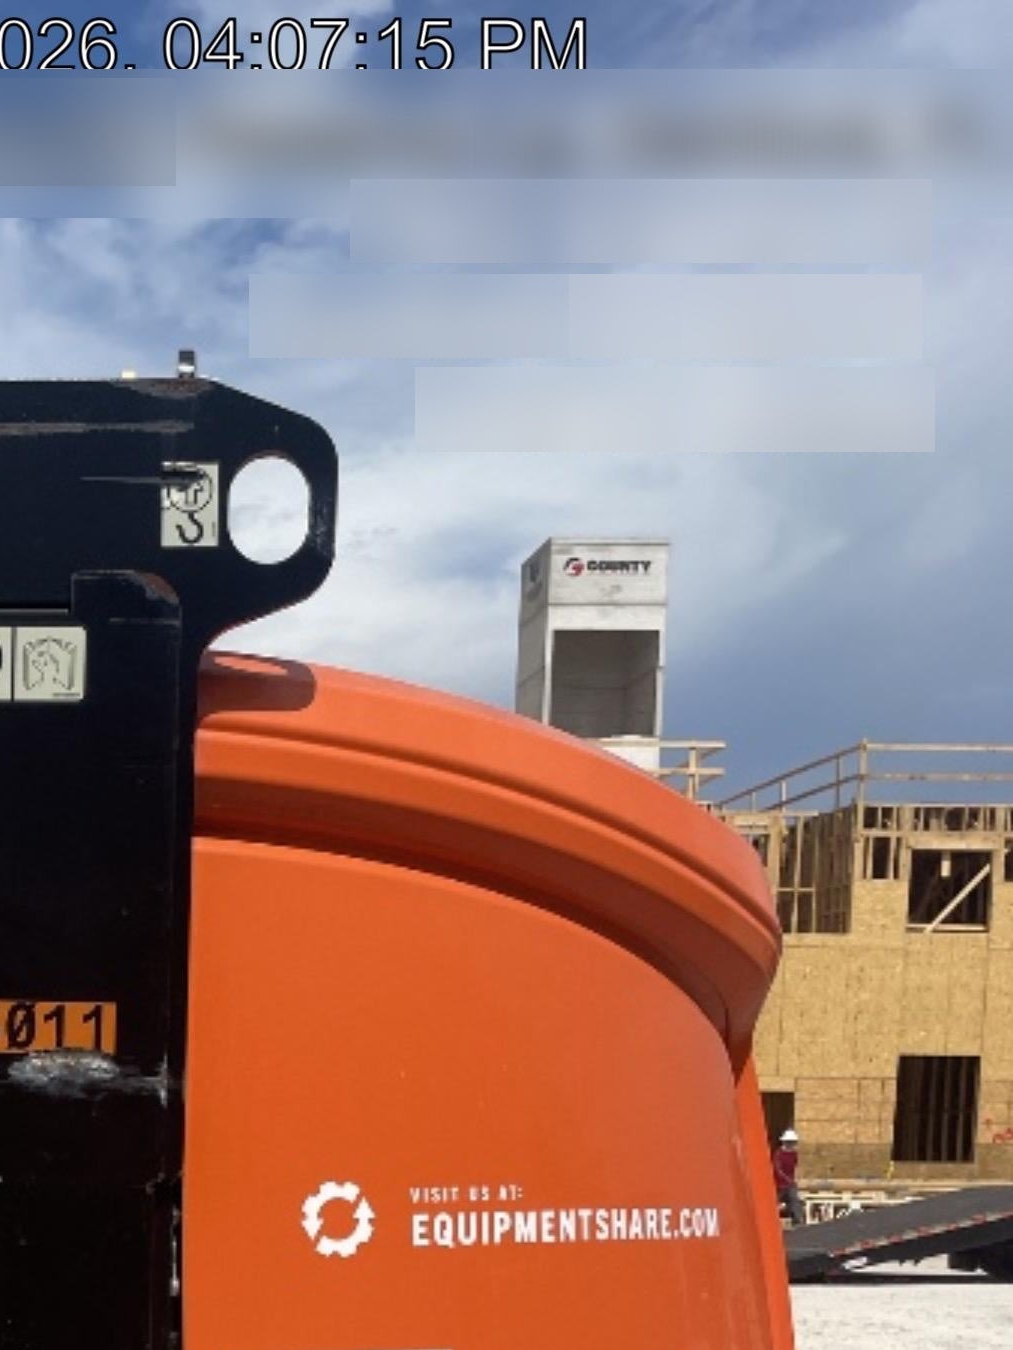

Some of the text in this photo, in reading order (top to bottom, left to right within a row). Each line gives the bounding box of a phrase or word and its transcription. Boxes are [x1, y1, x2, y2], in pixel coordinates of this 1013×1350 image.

[409, 1184, 523, 1204] VISIT US AT:
[411, 1207, 720, 1248] EQUIPMENTSHARE.COM
